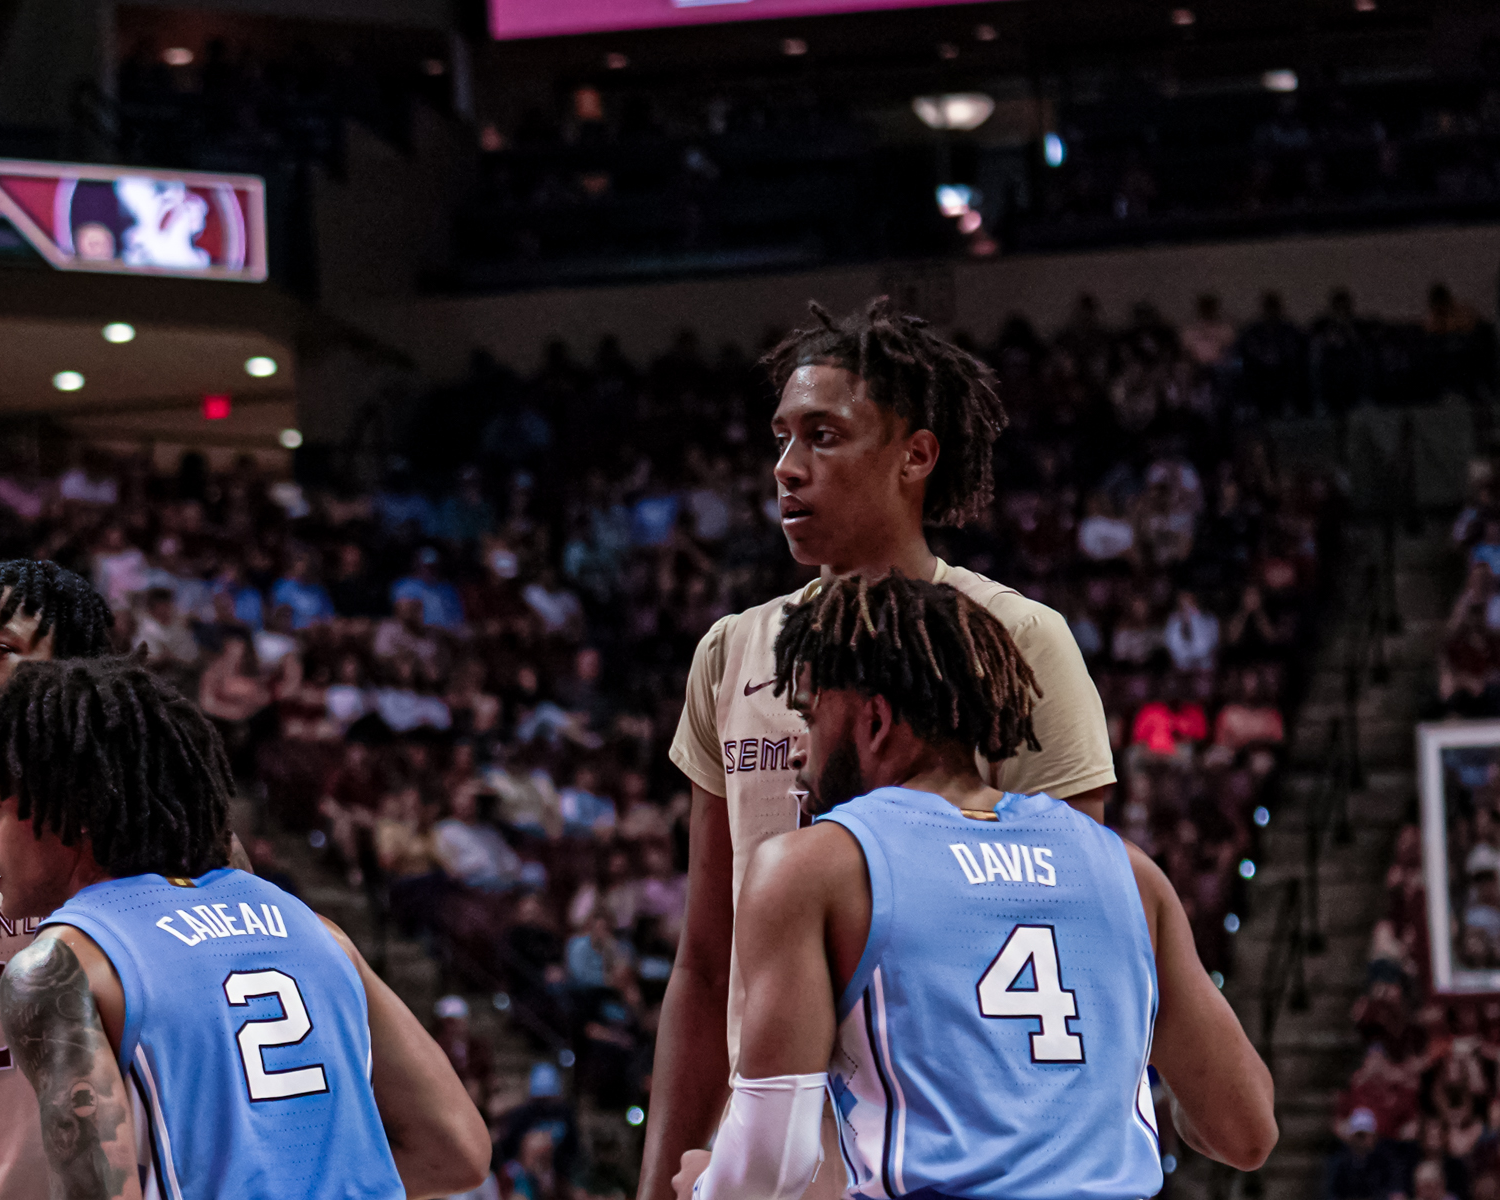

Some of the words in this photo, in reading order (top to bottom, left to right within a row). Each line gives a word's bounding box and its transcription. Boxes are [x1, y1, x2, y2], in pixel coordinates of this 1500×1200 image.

[724, 736, 799, 774] SEM
[949, 842, 1057, 887] DAVIS
[155, 902, 289, 948] CADEAU
[976, 924, 1086, 1064] 4
[223, 967, 330, 1102] 2
